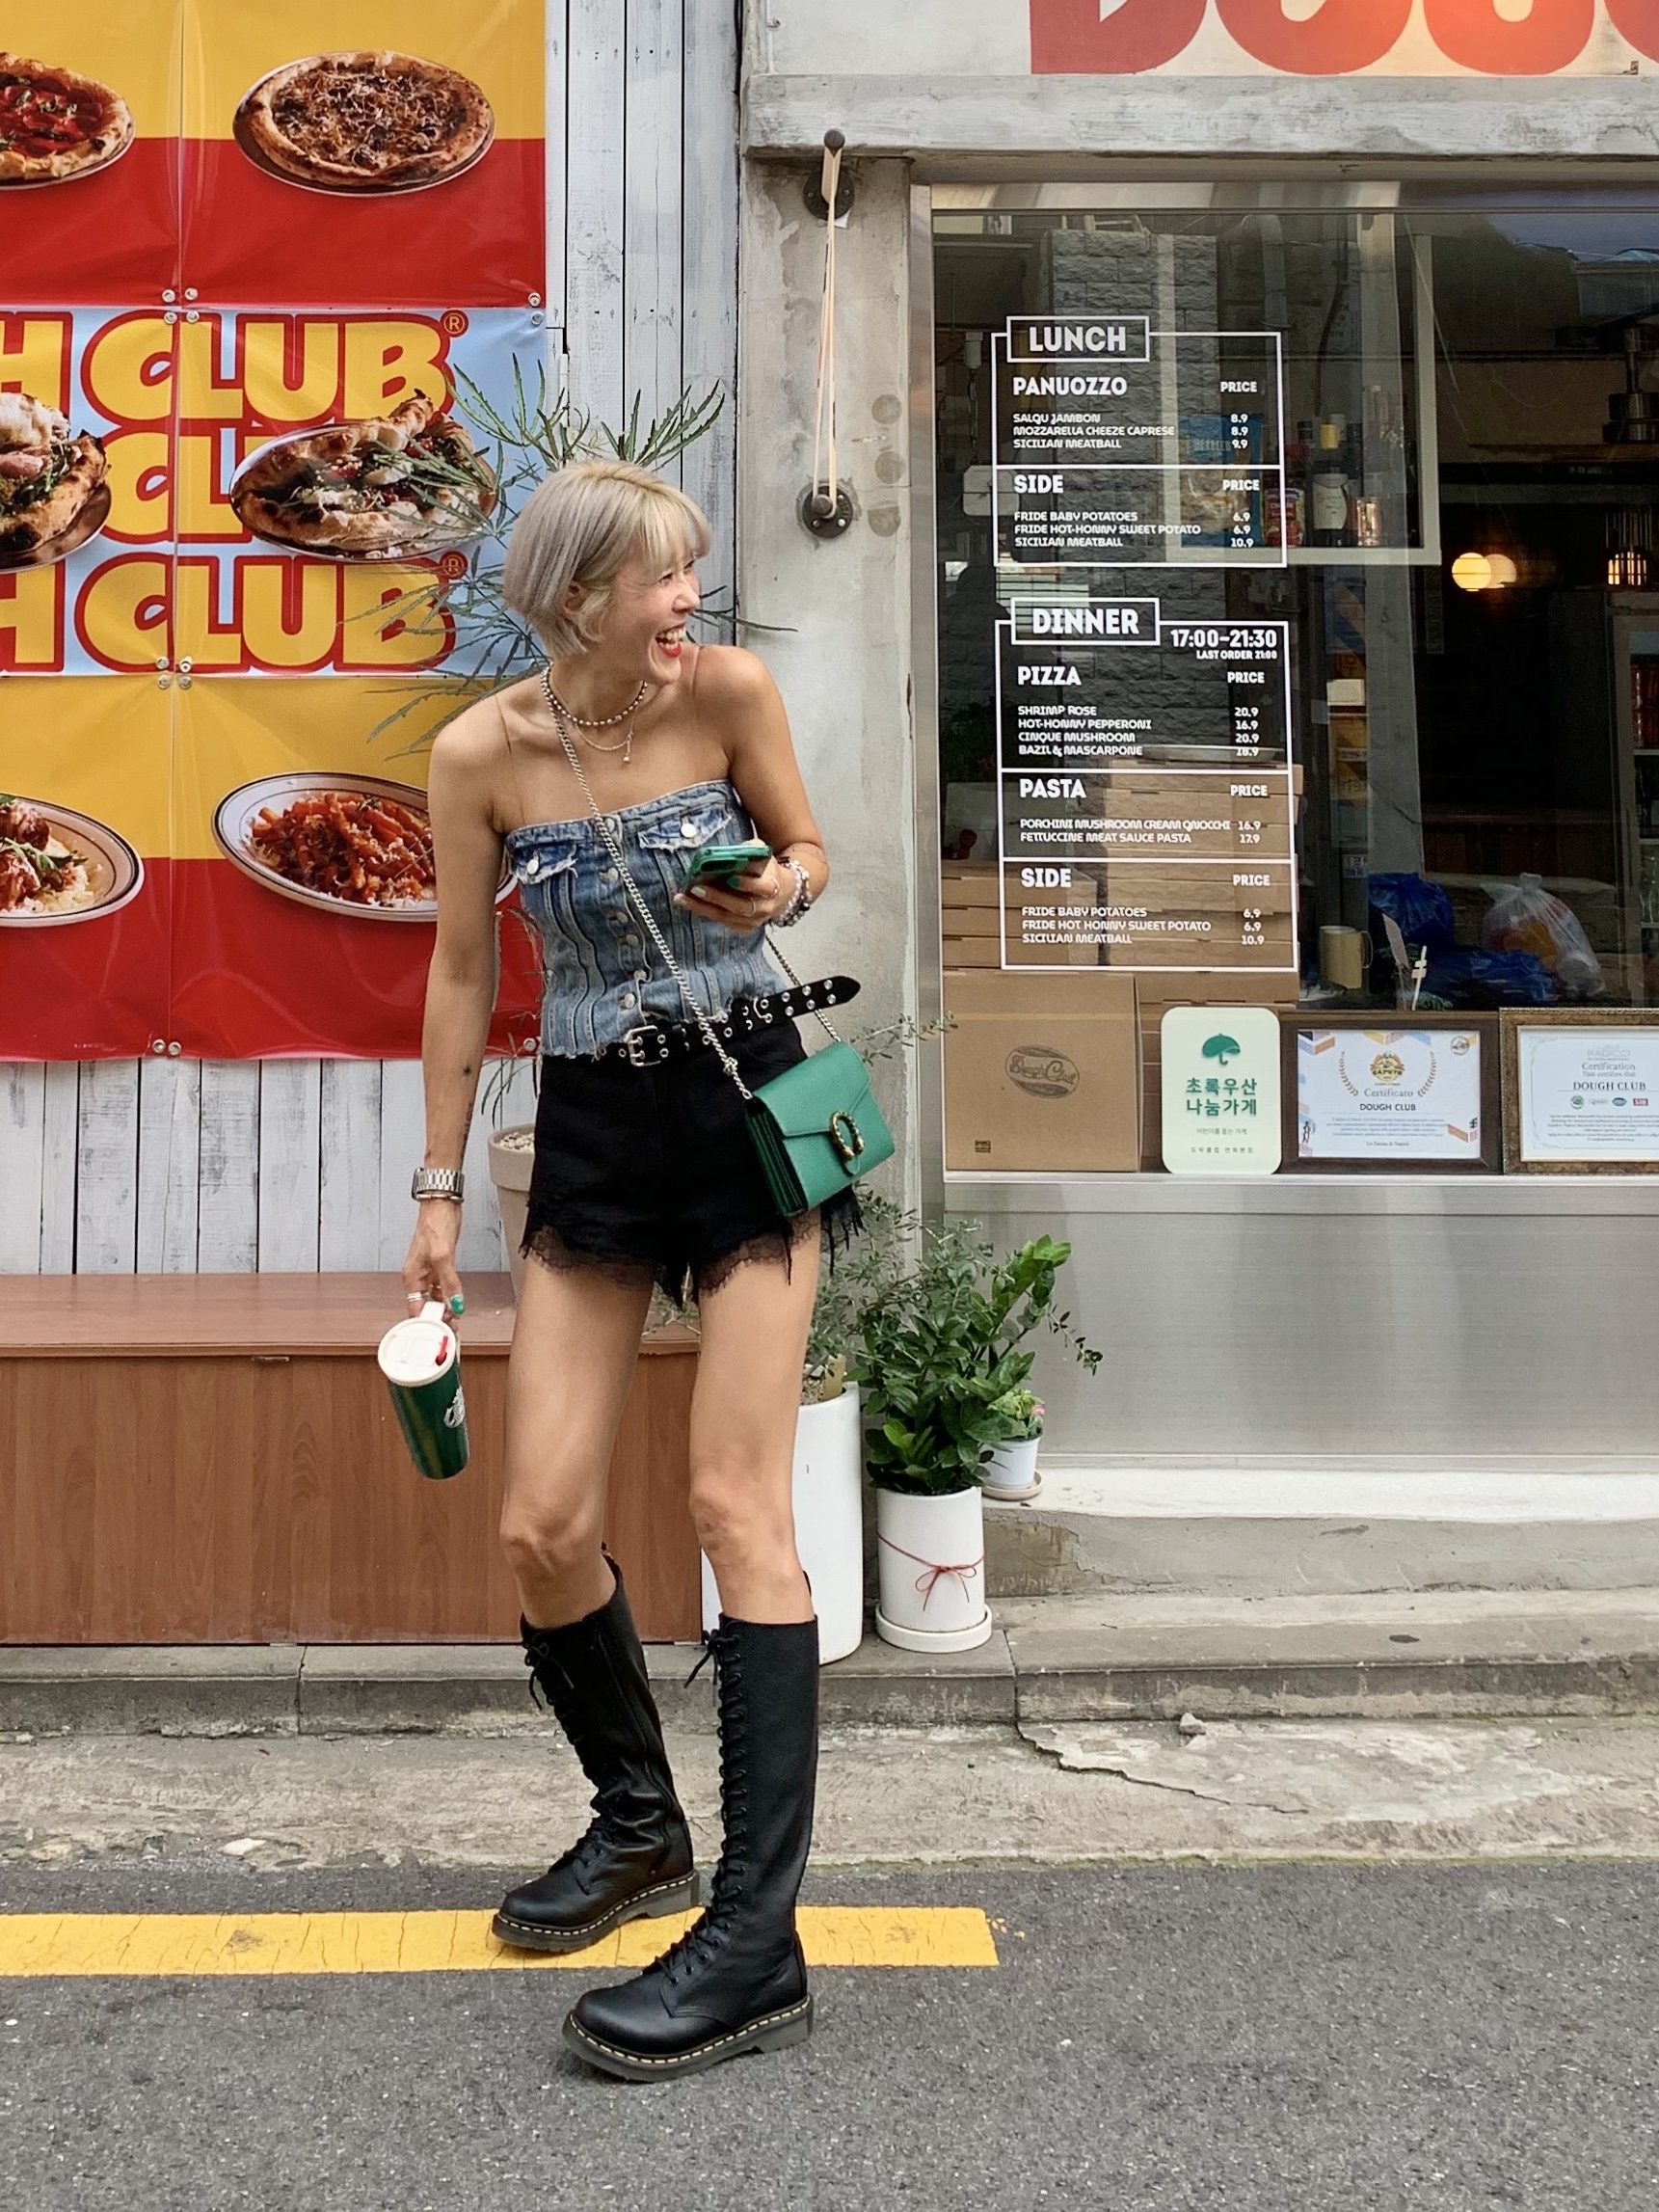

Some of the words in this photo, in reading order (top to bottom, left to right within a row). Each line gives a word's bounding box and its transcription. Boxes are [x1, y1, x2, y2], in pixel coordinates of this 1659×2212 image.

[1030, 327, 1126, 352] LUNCH
[1013, 377, 1127, 395] PANUOZZO
[1220, 382, 1257, 392] PRICE
[1051, 414, 1100, 425] JAMBON
[1014, 426, 1084, 435] MOZZARELLA
[1086, 426, 1125, 435] CHEEZE
[1128, 426, 1174, 435] CAPRESE
[1231, 427, 1248, 436] 8.9
[1014, 440, 1062, 448] SICILIAN
[1065, 440, 1121, 448] MEATBALL
[1232, 440, 1247, 448] 9.9
[98, 429, 252, 543] CL
[1014, 475, 1063, 494] SIDE
[1223, 480, 1260, 490] PRICE
[1014, 512, 1047, 521] FRIDE
[1050, 512, 1081, 521] BABY
[1083, 512, 1137, 521] POTATOES
[1233, 512, 1250, 521] 6.9
[1234, 526, 1250, 534] 6.9
[1015, 538, 1064, 547] SICILIAN
[1067, 538, 1123, 547] MEATBALL
[1232, 538, 1253, 547] 10.9
[1033, 609, 1138, 634] DINNER
[1018, 666, 1081, 686] PIZZA
[1228, 672, 1265, 683] PRICE
[1018, 706, 1064, 715] SHRIMP
[1068, 706, 1096, 715] ROSE
[1235, 708, 1258, 716] 20.9
[1088, 719, 1151, 729] PEPPERONI
[1236, 720, 1258, 730] 16.9
[1019, 733, 1061, 742] CINQUE
[1064, 733, 1135, 742] MUSHROOM
[1235, 734, 1259, 743] 20.9
[1019, 745, 1051, 755] BAZIL
[1053, 745, 1062, 756] &
[1064, 745, 1142, 755] MASCARPONE
[1237, 747, 1259, 756] 18.9
[1020, 779, 1086, 797] PASTA
[1231, 785, 1268, 796] PRICE
[1075, 820, 1142, 828] MUSHROOM
[1144, 820, 1181, 829] CREAM
[1239, 821, 1261, 830] 16.9
[1021, 833, 1084, 843] FETTUCCINE
[1086, 833, 1117, 843] MEAT
[1120, 833, 1155, 843] SAUCE
[1157, 833, 1191, 843] PASTA
[1240, 834, 1260, 844] 17.9
[1021, 869, 1071, 887] SIDE
[1233, 875, 1270, 885] PRICE
[1022, 907, 1056, 916] FRIDE
[1057, 907, 1088, 916] BABY
[1090, 907, 1147, 916] POTATOES
[1244, 908, 1261, 918] 6.9
[1022, 921, 1056, 930] FRIDE
[1058, 921, 1082, 930] HOT
[1084, 921, 1126, 931] HONNY
[1129, 921, 1165, 931] SWEET
[1168, 921, 1211, 931] POTATO
[1244, 922, 1261, 931] 6.9
[1023, 934, 1073, 943] SICILIAN
[1076, 934, 1133, 944] MEATBALL
[1242, 935, 1264, 945] 10.9
[1186, 1077, 1257, 1095] 초록우산
[1573, 1082, 1614, 1091] DOUGH
[1618, 1082, 1646, 1091] CLUB
[1364, 1088, 1413, 1097] Certificato
[1187, 1098, 1257, 1116] 나눔가게
